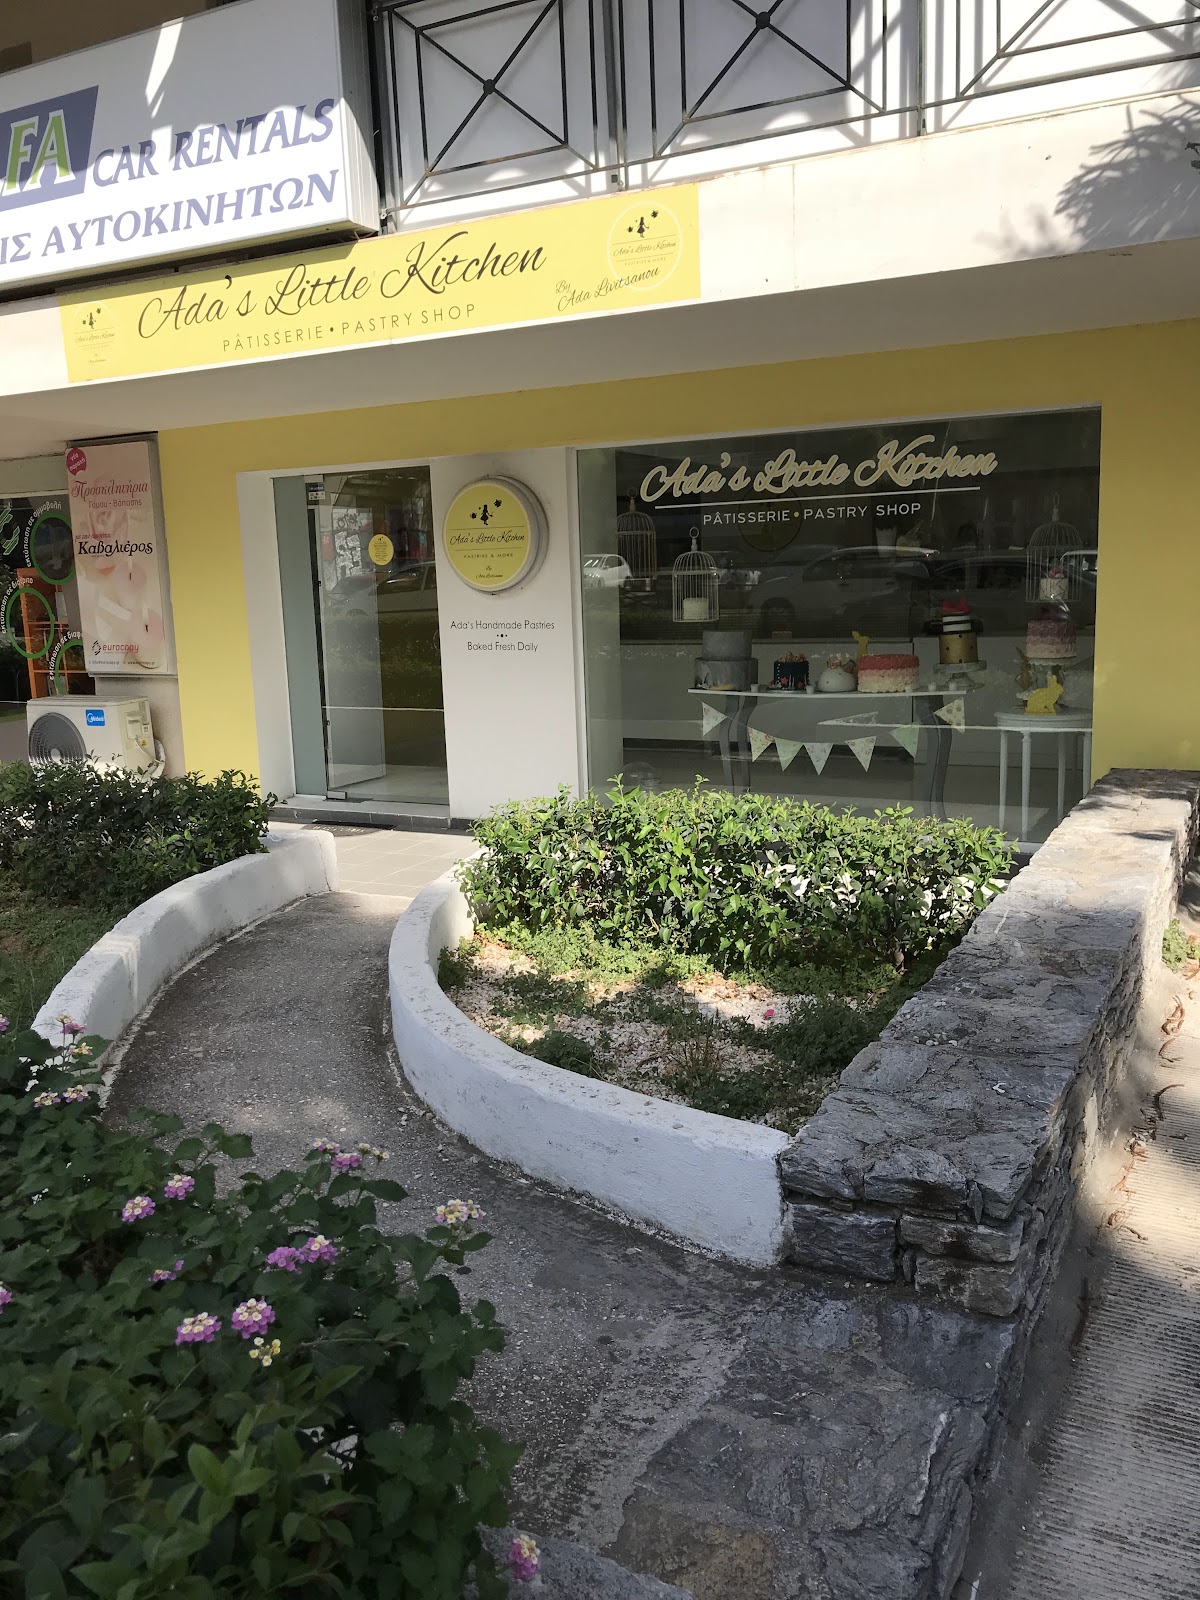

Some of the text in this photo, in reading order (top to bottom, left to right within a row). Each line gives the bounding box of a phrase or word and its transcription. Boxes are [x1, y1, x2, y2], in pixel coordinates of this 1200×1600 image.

[93, 139, 157, 187] CAR
[172, 98, 335, 171] RENTALS
[41, 169, 340, 257] ΑΥΤΟΚΙΝΗΤΩΝ
[138, 231, 547, 339] Ada's Little Kitchen
[555, 280, 571, 295] By
[557, 289, 592, 312] Ada
[222, 303, 475, 352] PÂTISSERIE PASTRY SHOP
[639, 434, 999, 502] Ada's Little Kitchen
[703, 502, 922, 526] PÂTISSERIE PASTRY SHOP
[78, 540, 153, 557] Καβαλιέρος
[449, 529, 526, 546] Ada's Little Kitchen
[450, 619, 555, 630] Ada's Handmade Pastries
[467, 641, 538, 652] Baked Fresh Daily
